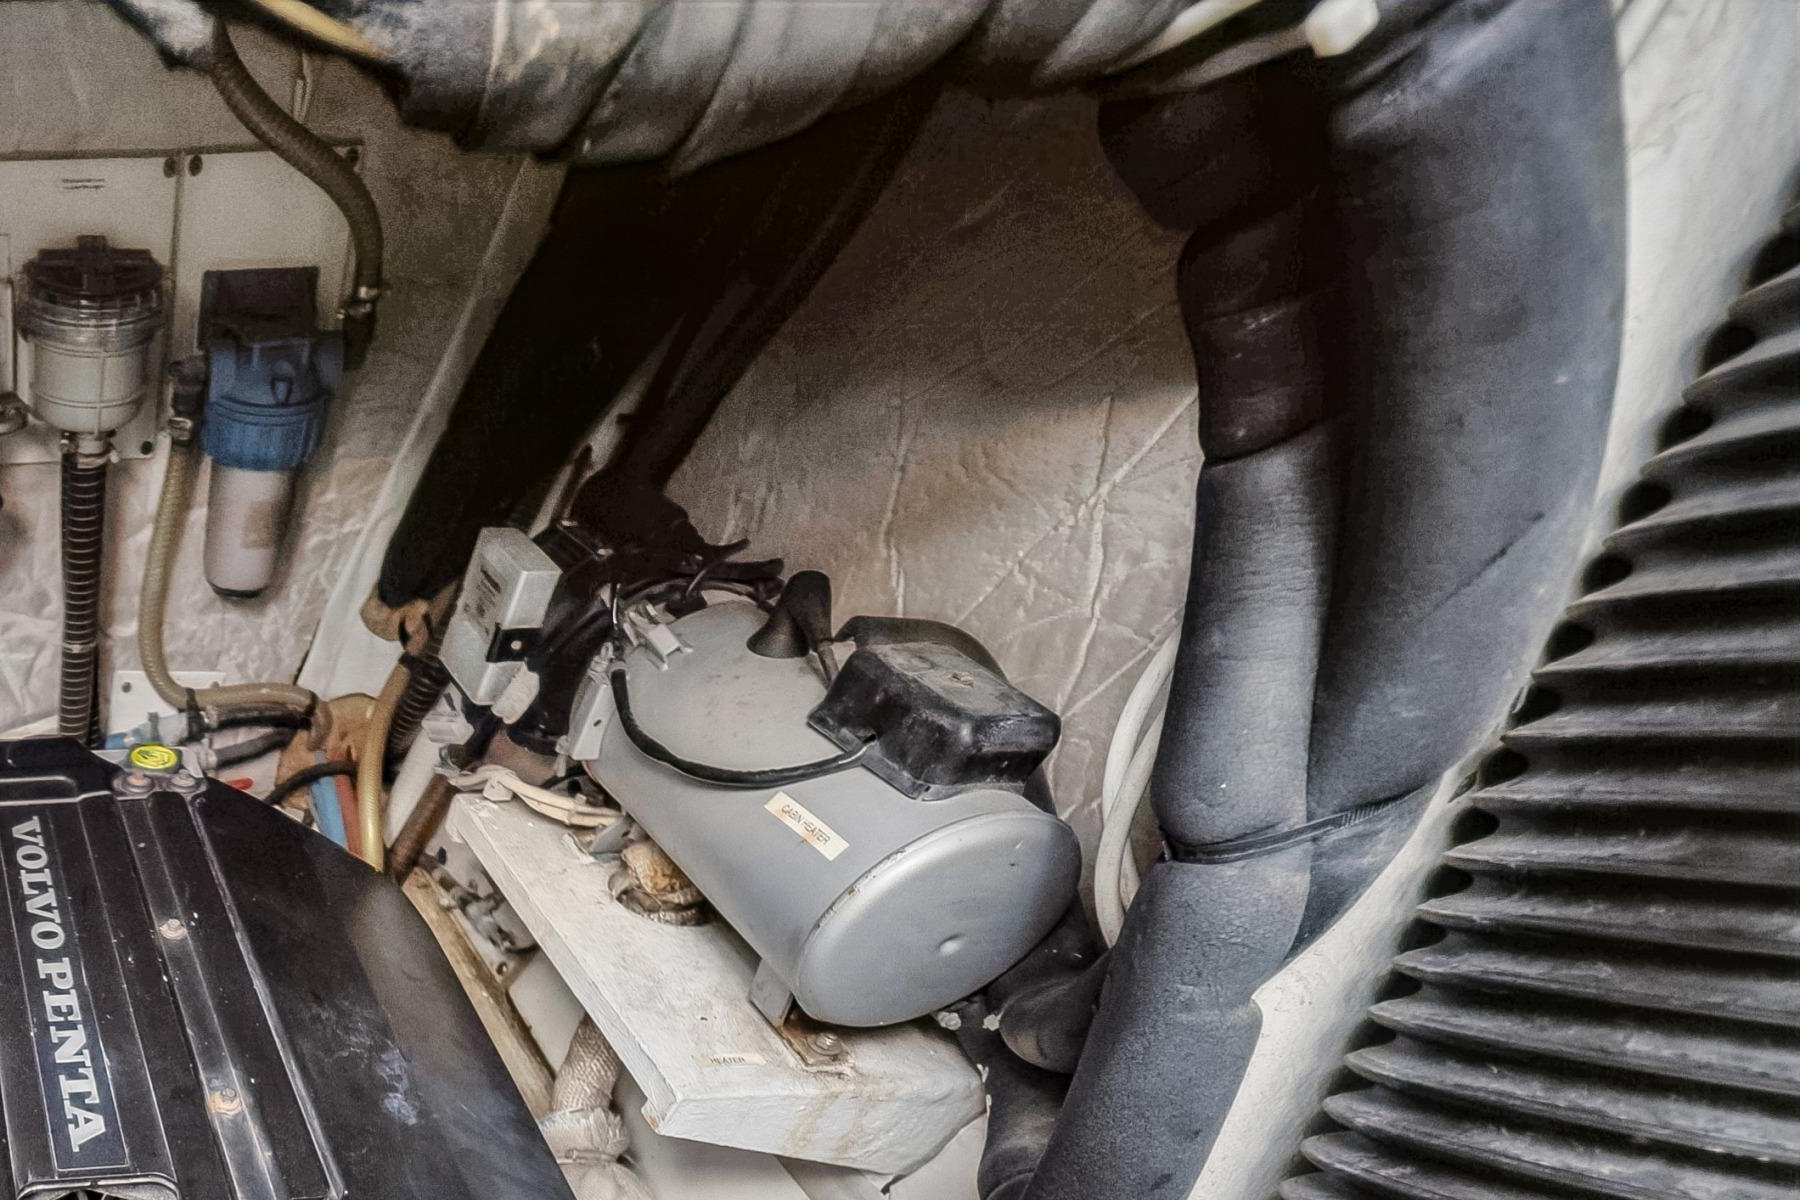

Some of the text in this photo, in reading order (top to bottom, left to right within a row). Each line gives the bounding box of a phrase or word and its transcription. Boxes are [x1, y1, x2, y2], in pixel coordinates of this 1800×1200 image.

[781, 804, 831, 846] CABIN HEATER
[11, 815, 106, 1153] VOLVO PENTA
